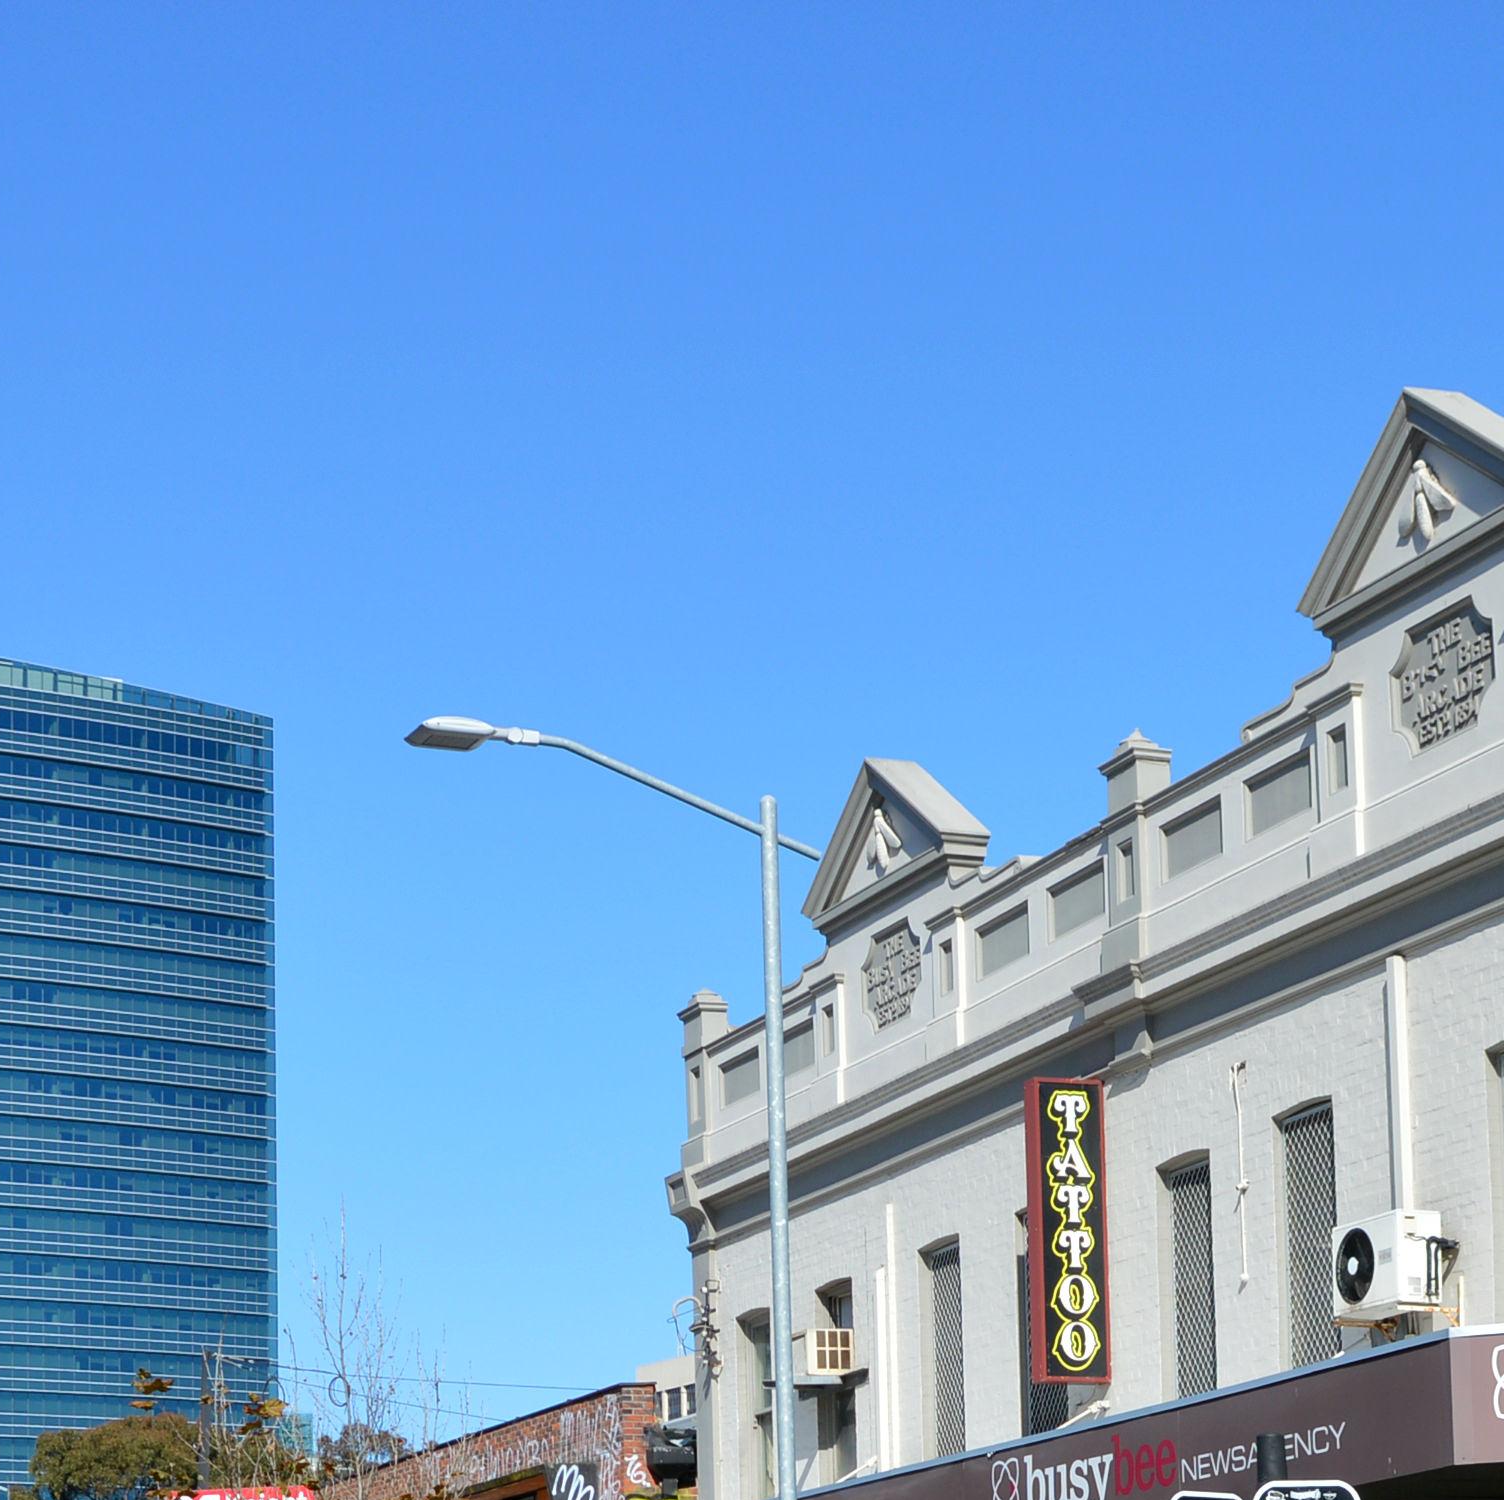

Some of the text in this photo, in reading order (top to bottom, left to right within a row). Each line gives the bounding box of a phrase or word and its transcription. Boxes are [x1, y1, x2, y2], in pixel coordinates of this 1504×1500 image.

[1427, 617, 1463, 659] THE
[1457, 632, 1492, 675] BEE
[1417, 661, 1485, 721] ARCADE
[1051, 1093, 1098, 1365] TATTOO
[1180, 1422, 1346, 1484] NEWSAENCY
